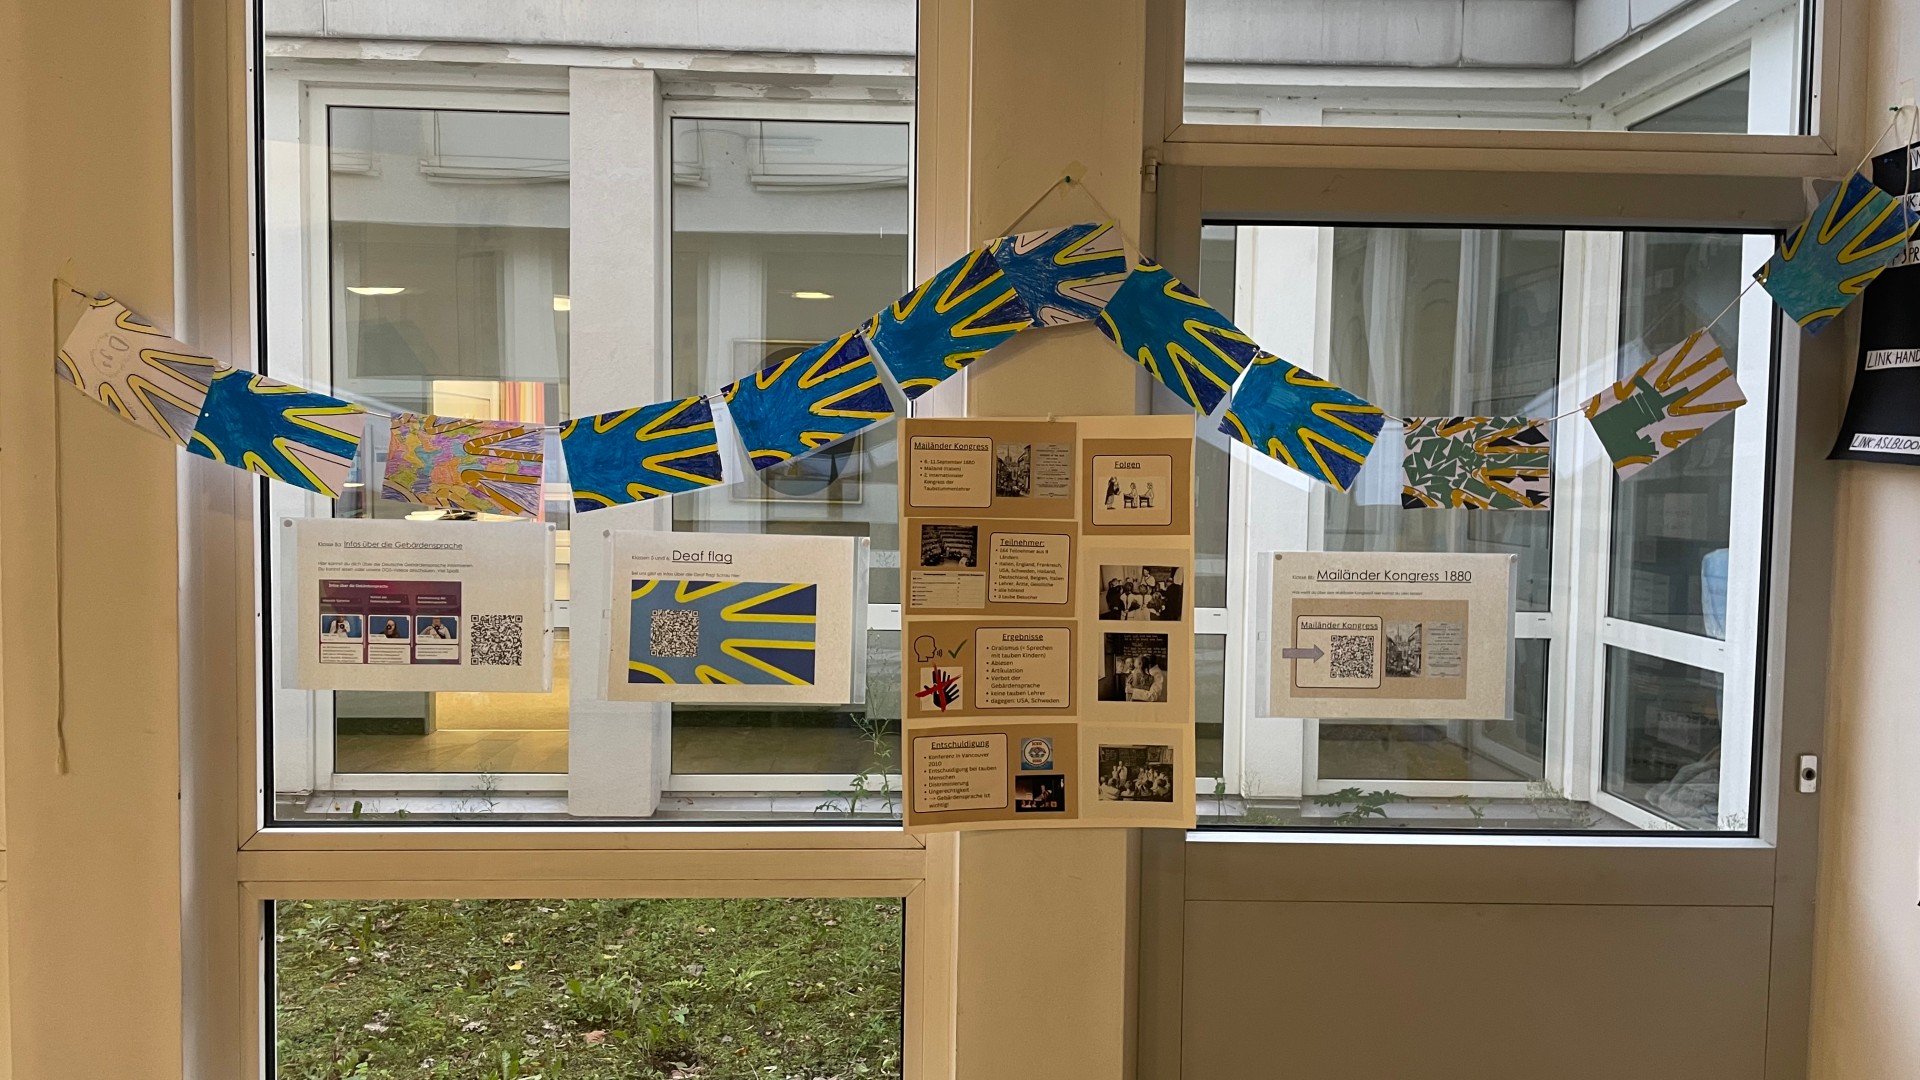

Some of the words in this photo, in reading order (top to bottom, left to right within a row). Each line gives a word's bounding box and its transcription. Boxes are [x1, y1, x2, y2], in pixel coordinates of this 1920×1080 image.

[1867, 352, 1892, 368] LINK
[914, 442, 952, 450] Mailänder
[954, 443, 988, 451] Kongress
[1114, 460, 1140, 469] Folgen
[1342, 622, 1378, 630] Kongress
[1002, 633, 1044, 642] Ergebnisse
[931, 741, 990, 750] Entschuldigung
